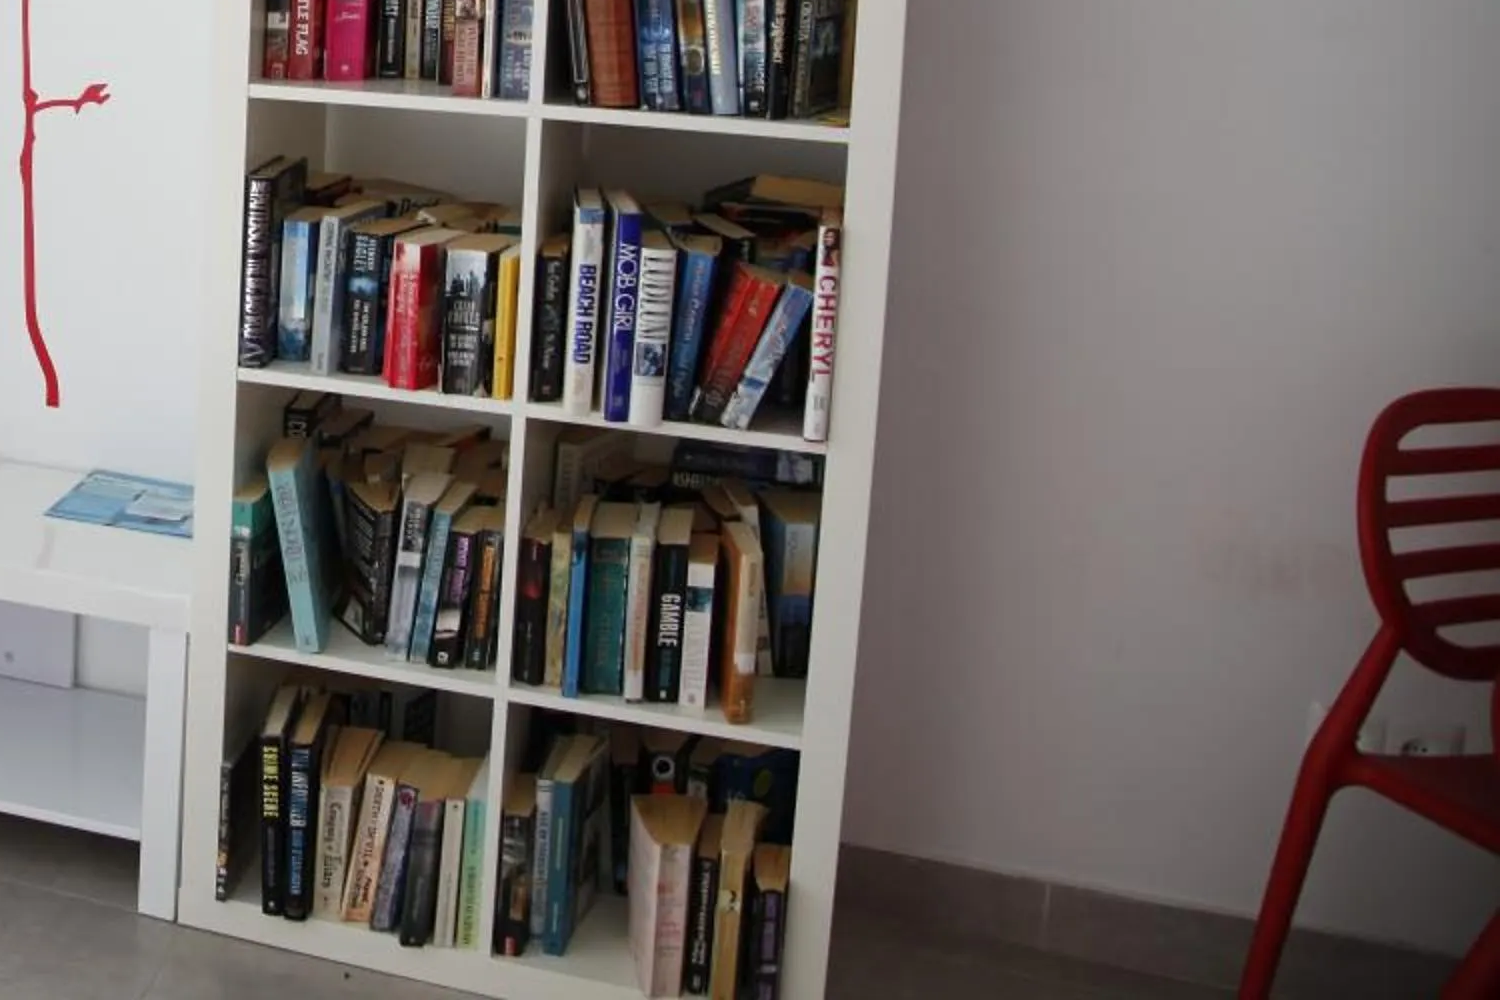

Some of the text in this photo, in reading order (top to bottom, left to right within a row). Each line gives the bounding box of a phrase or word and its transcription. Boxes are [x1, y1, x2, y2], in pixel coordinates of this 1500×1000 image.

[295, 21, 311, 56] FLAG
[572, 263, 597, 365] BEACH ROAD
[613, 242, 638, 335] MOB GIRL
[638, 254, 677, 341] LUDLUM
[812, 276, 838, 382] CHERYL
[657, 593, 681, 647] GAMBLE
[263, 745, 280, 819] CRIME SCENE
